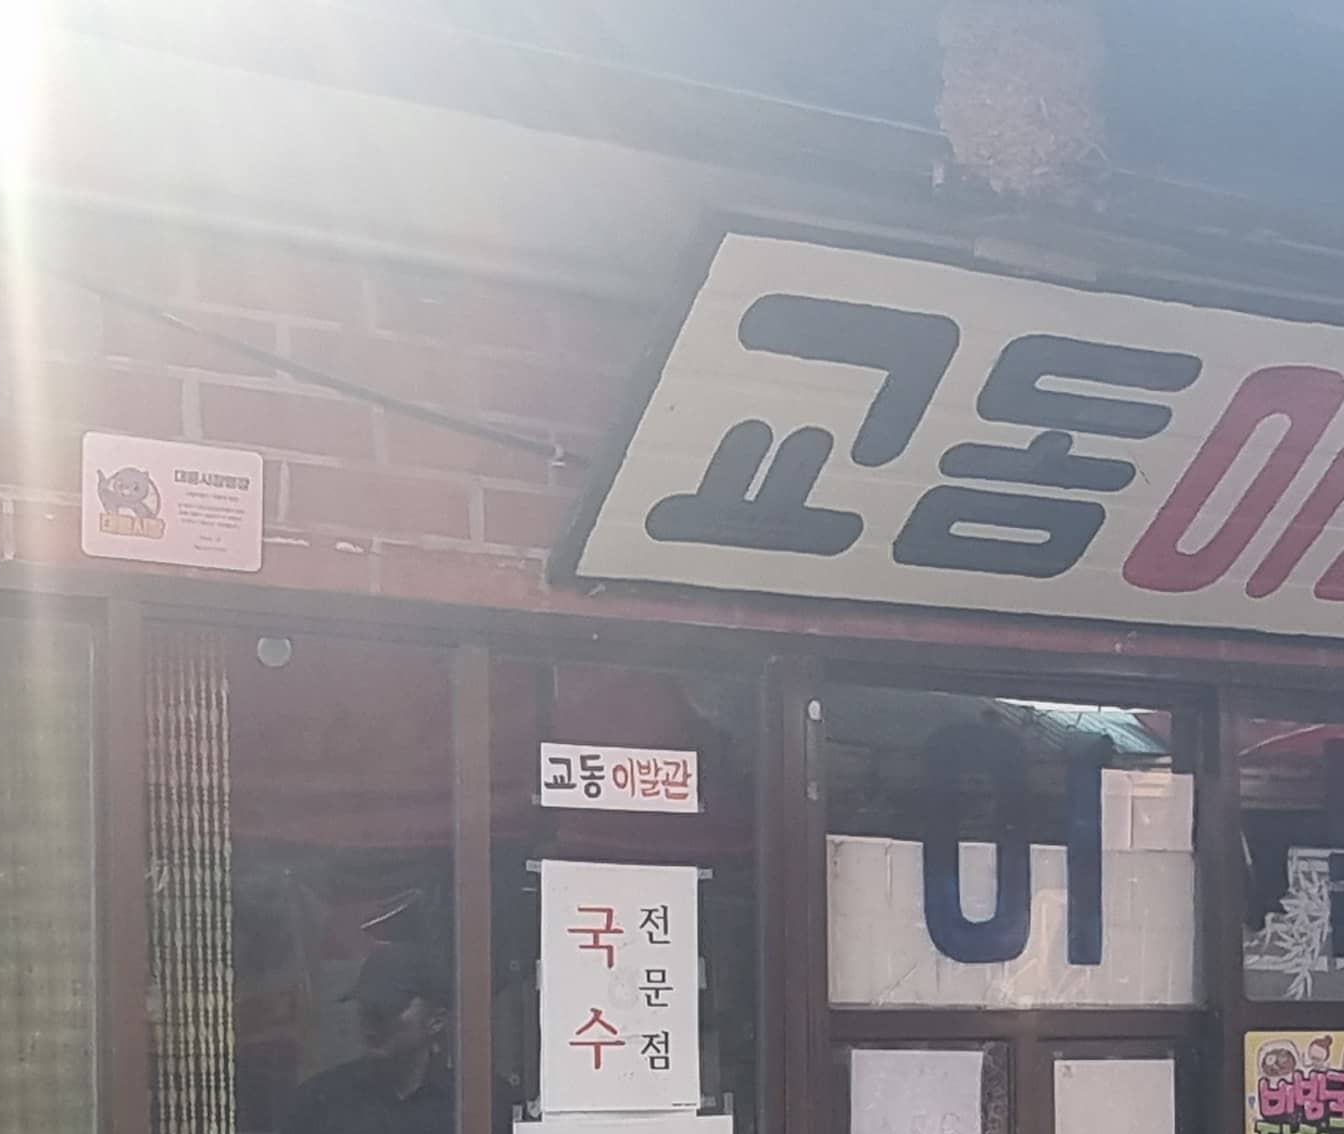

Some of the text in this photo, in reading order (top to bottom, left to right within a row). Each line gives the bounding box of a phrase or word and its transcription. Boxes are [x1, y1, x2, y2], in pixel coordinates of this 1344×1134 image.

[612, 756, 692, 801] 이발관
[567, 905, 626, 1070] 국수
[639, 904, 674, 1070] 전문점
